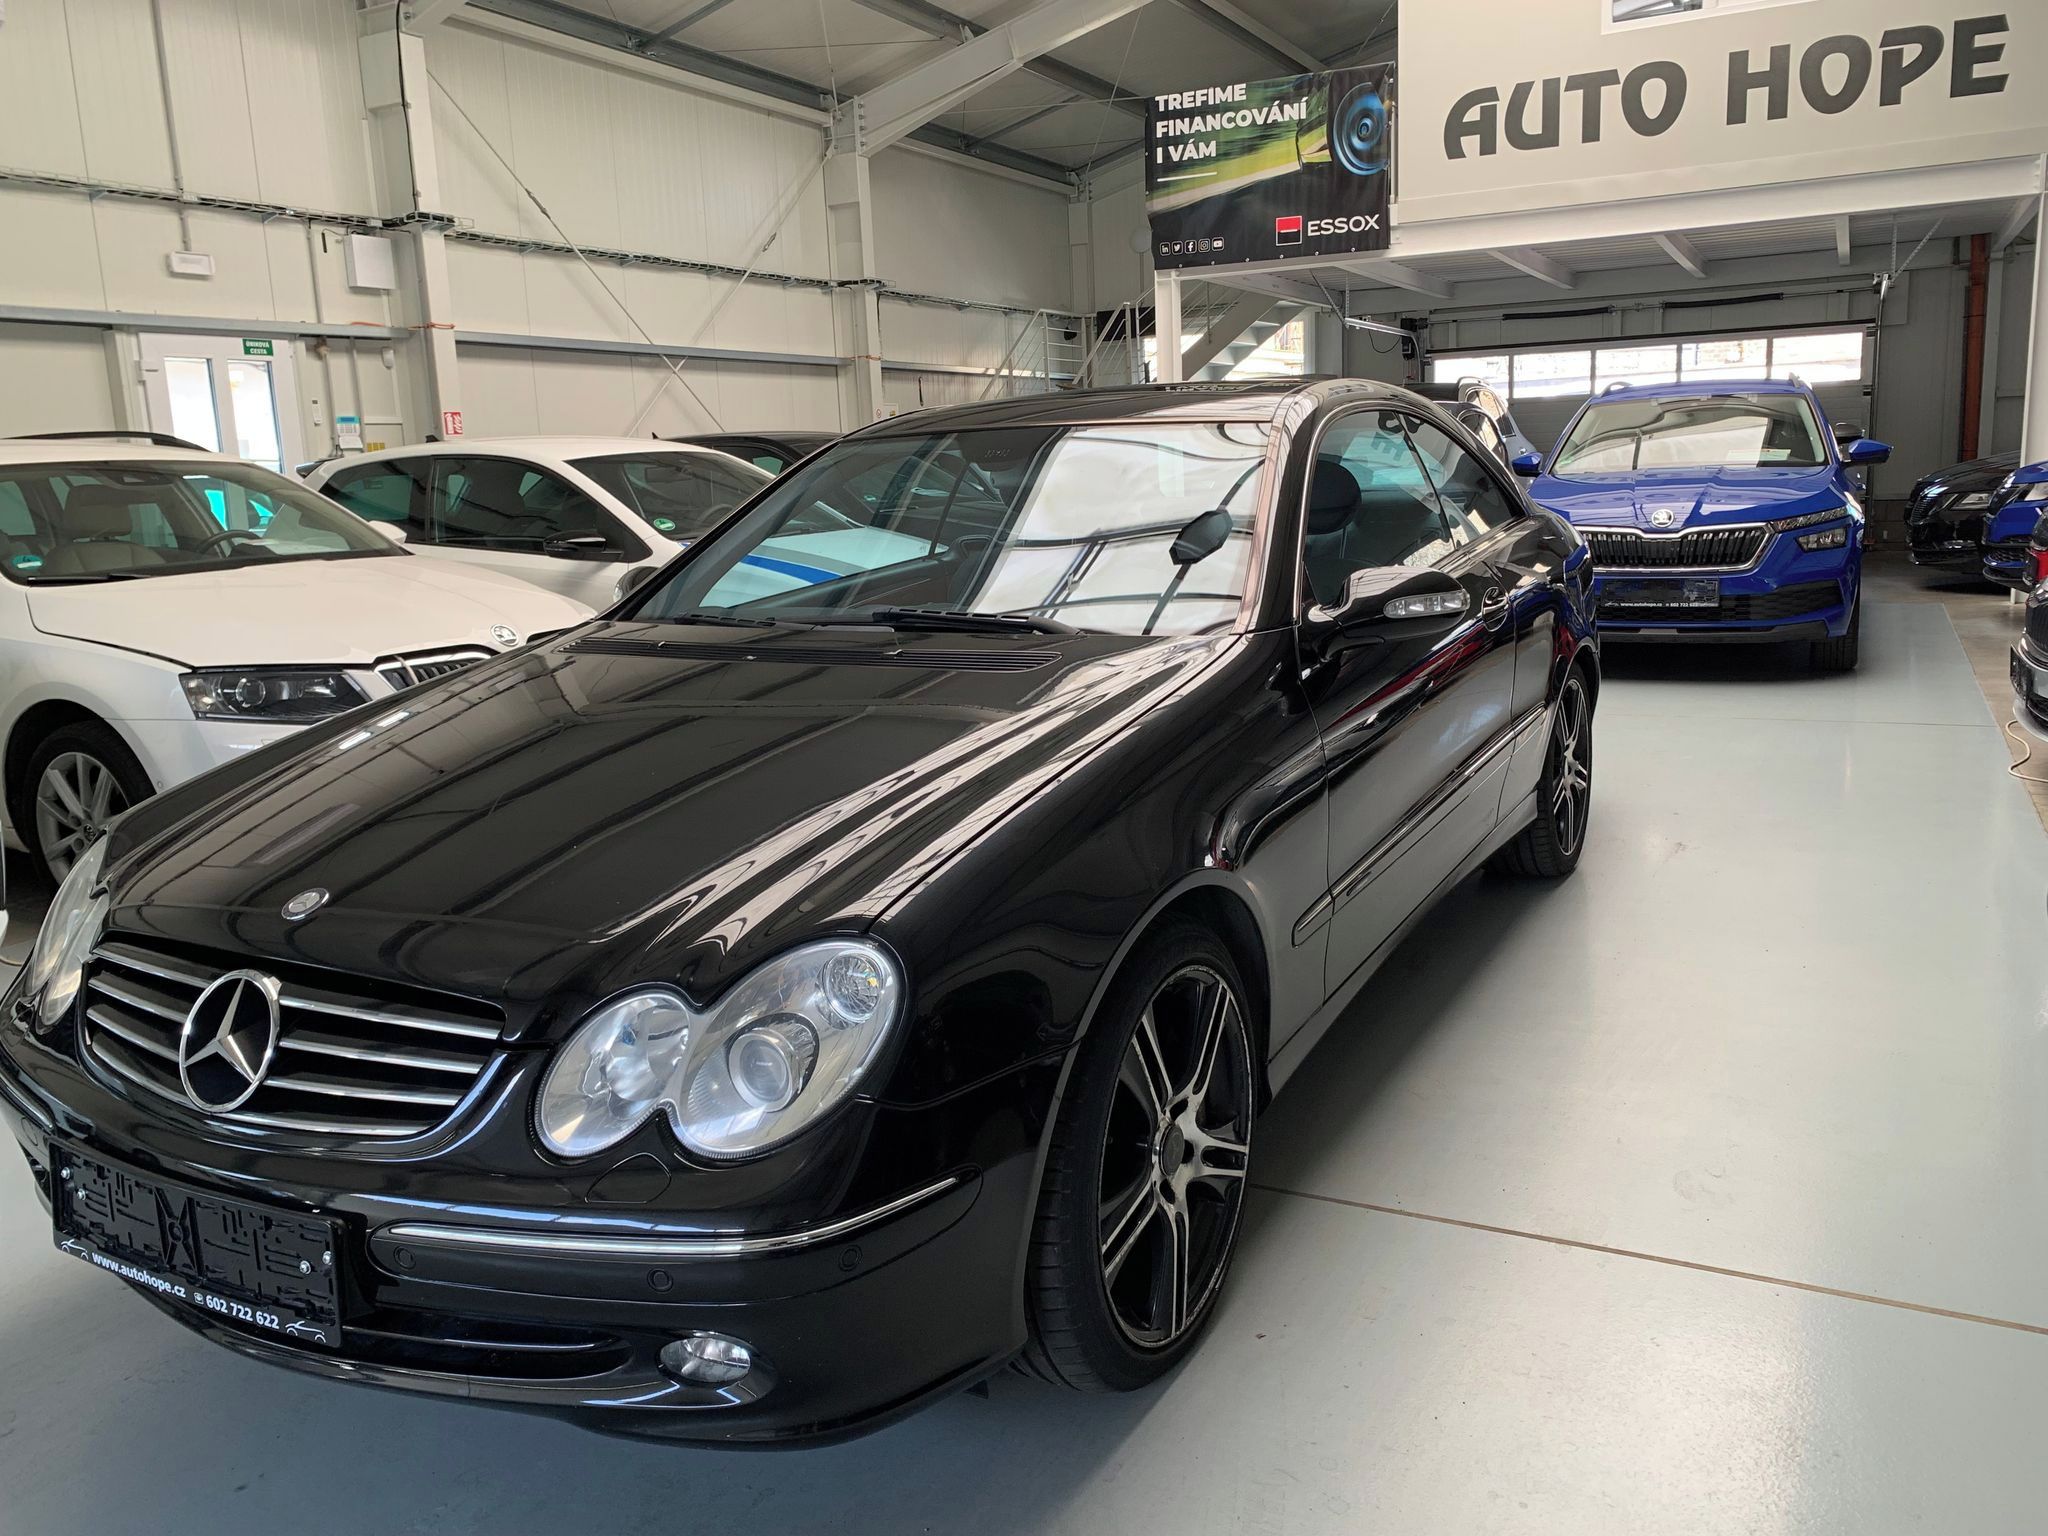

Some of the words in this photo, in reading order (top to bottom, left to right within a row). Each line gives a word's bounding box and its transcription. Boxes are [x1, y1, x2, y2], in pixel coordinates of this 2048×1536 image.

[1155, 83, 1247, 112] TREFIME
[1443, 61, 1687, 160] AUTO
[1726, 13, 2010, 126] HOPE
[1156, 96, 1308, 138] FINANCOVÁNÍ
[1156, 147, 1163, 164] I
[1168, 138, 1217, 162] VÁM
[1307, 213, 1380, 237] ESSOX
[91, 1252, 187, 1298] www.autohope.cz
[205, 1294, 229, 1314] 602
[230, 1301, 254, 1322] 722
[255, 1310, 280, 1330] 622
